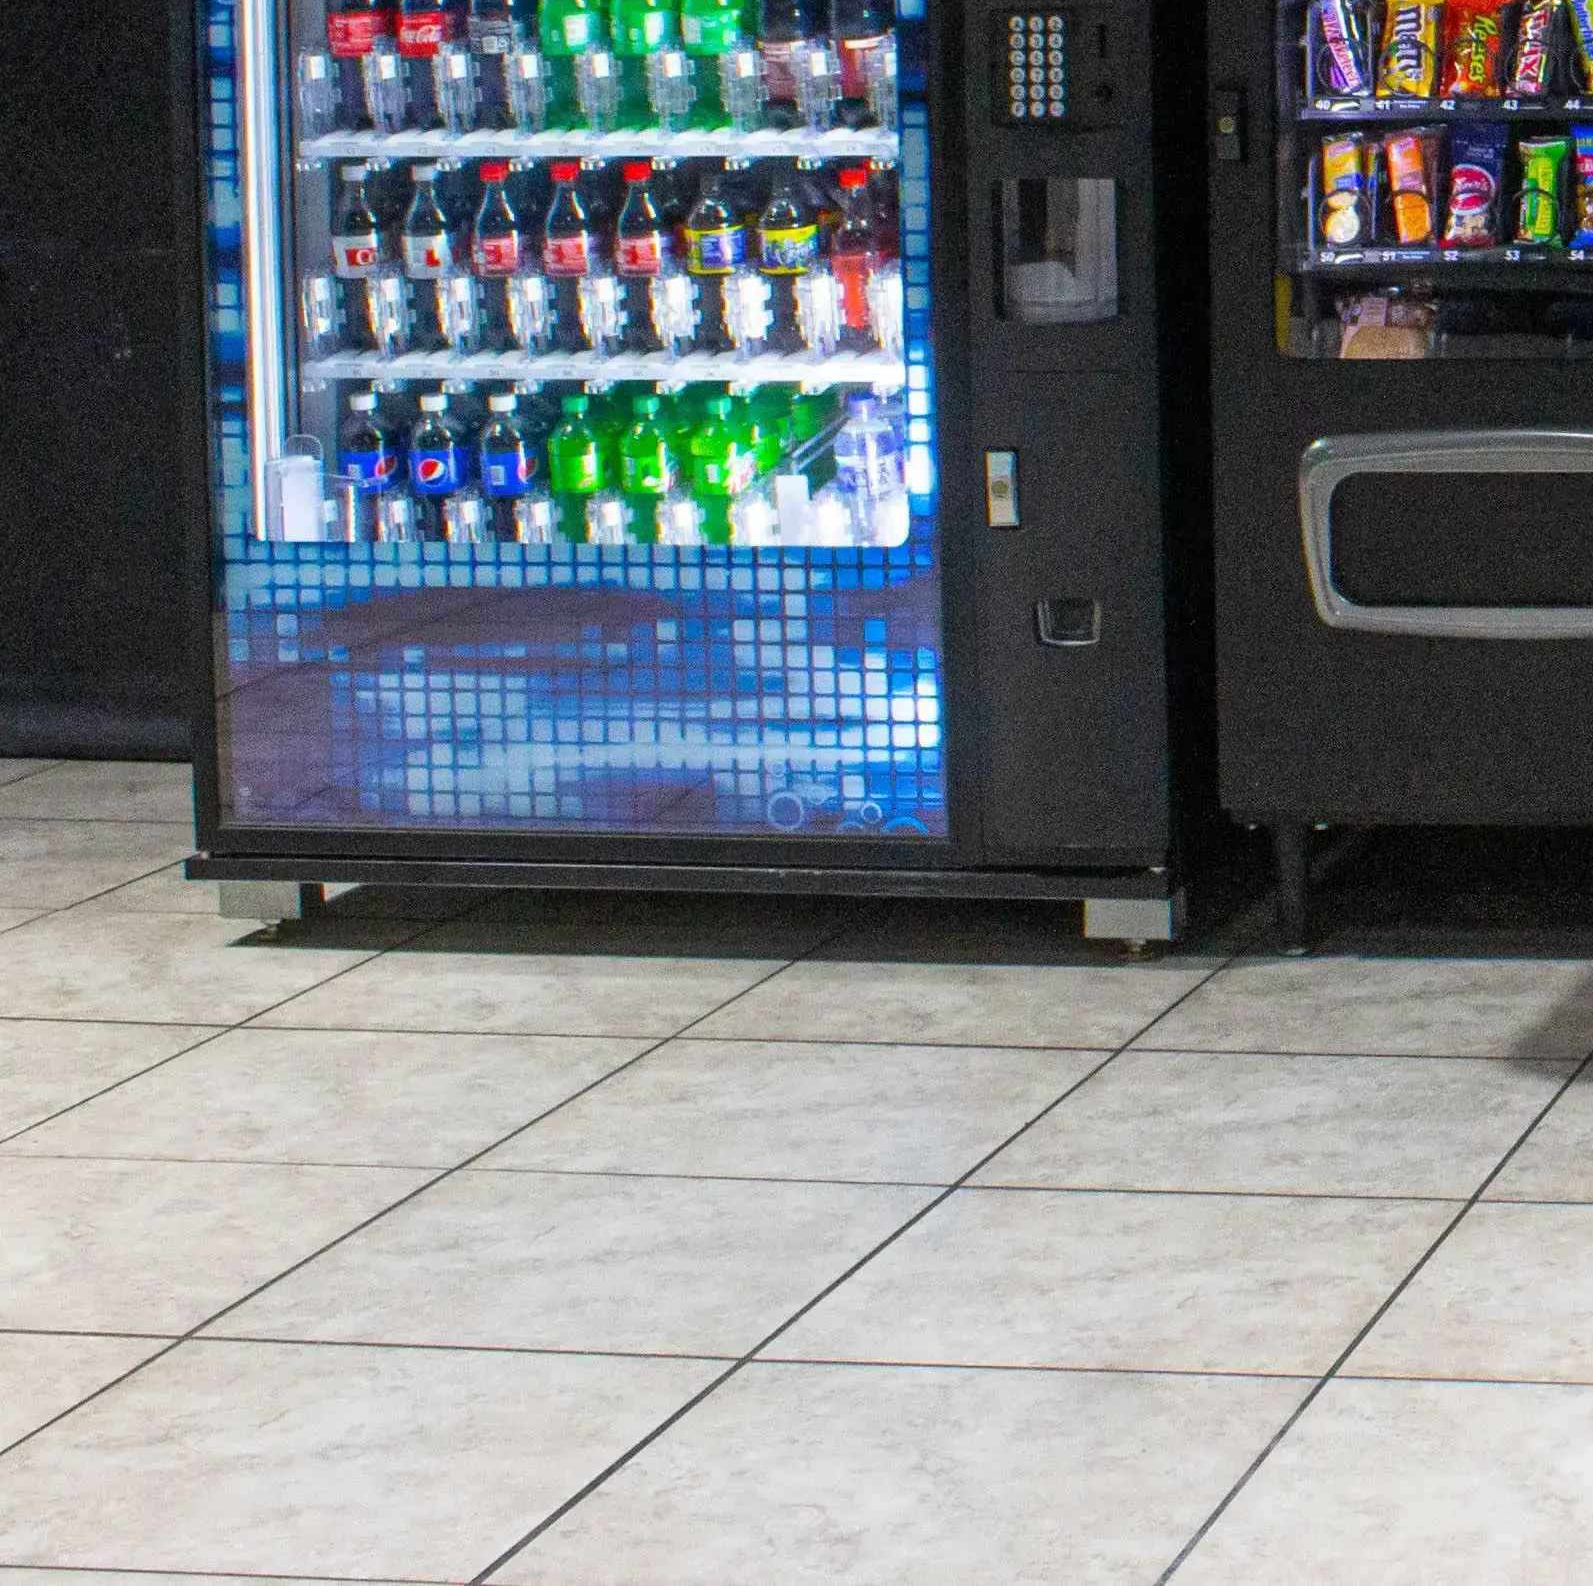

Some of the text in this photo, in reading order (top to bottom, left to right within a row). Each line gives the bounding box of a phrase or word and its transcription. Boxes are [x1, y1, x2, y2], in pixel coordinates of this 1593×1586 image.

[1440, 99, 1456, 111] 42
[1503, 99, 1518, 111] 43
[1444, 251, 1459, 262] 52
[1505, 251, 1520, 262] 53
[1570, 251, 1585, 262] 54
